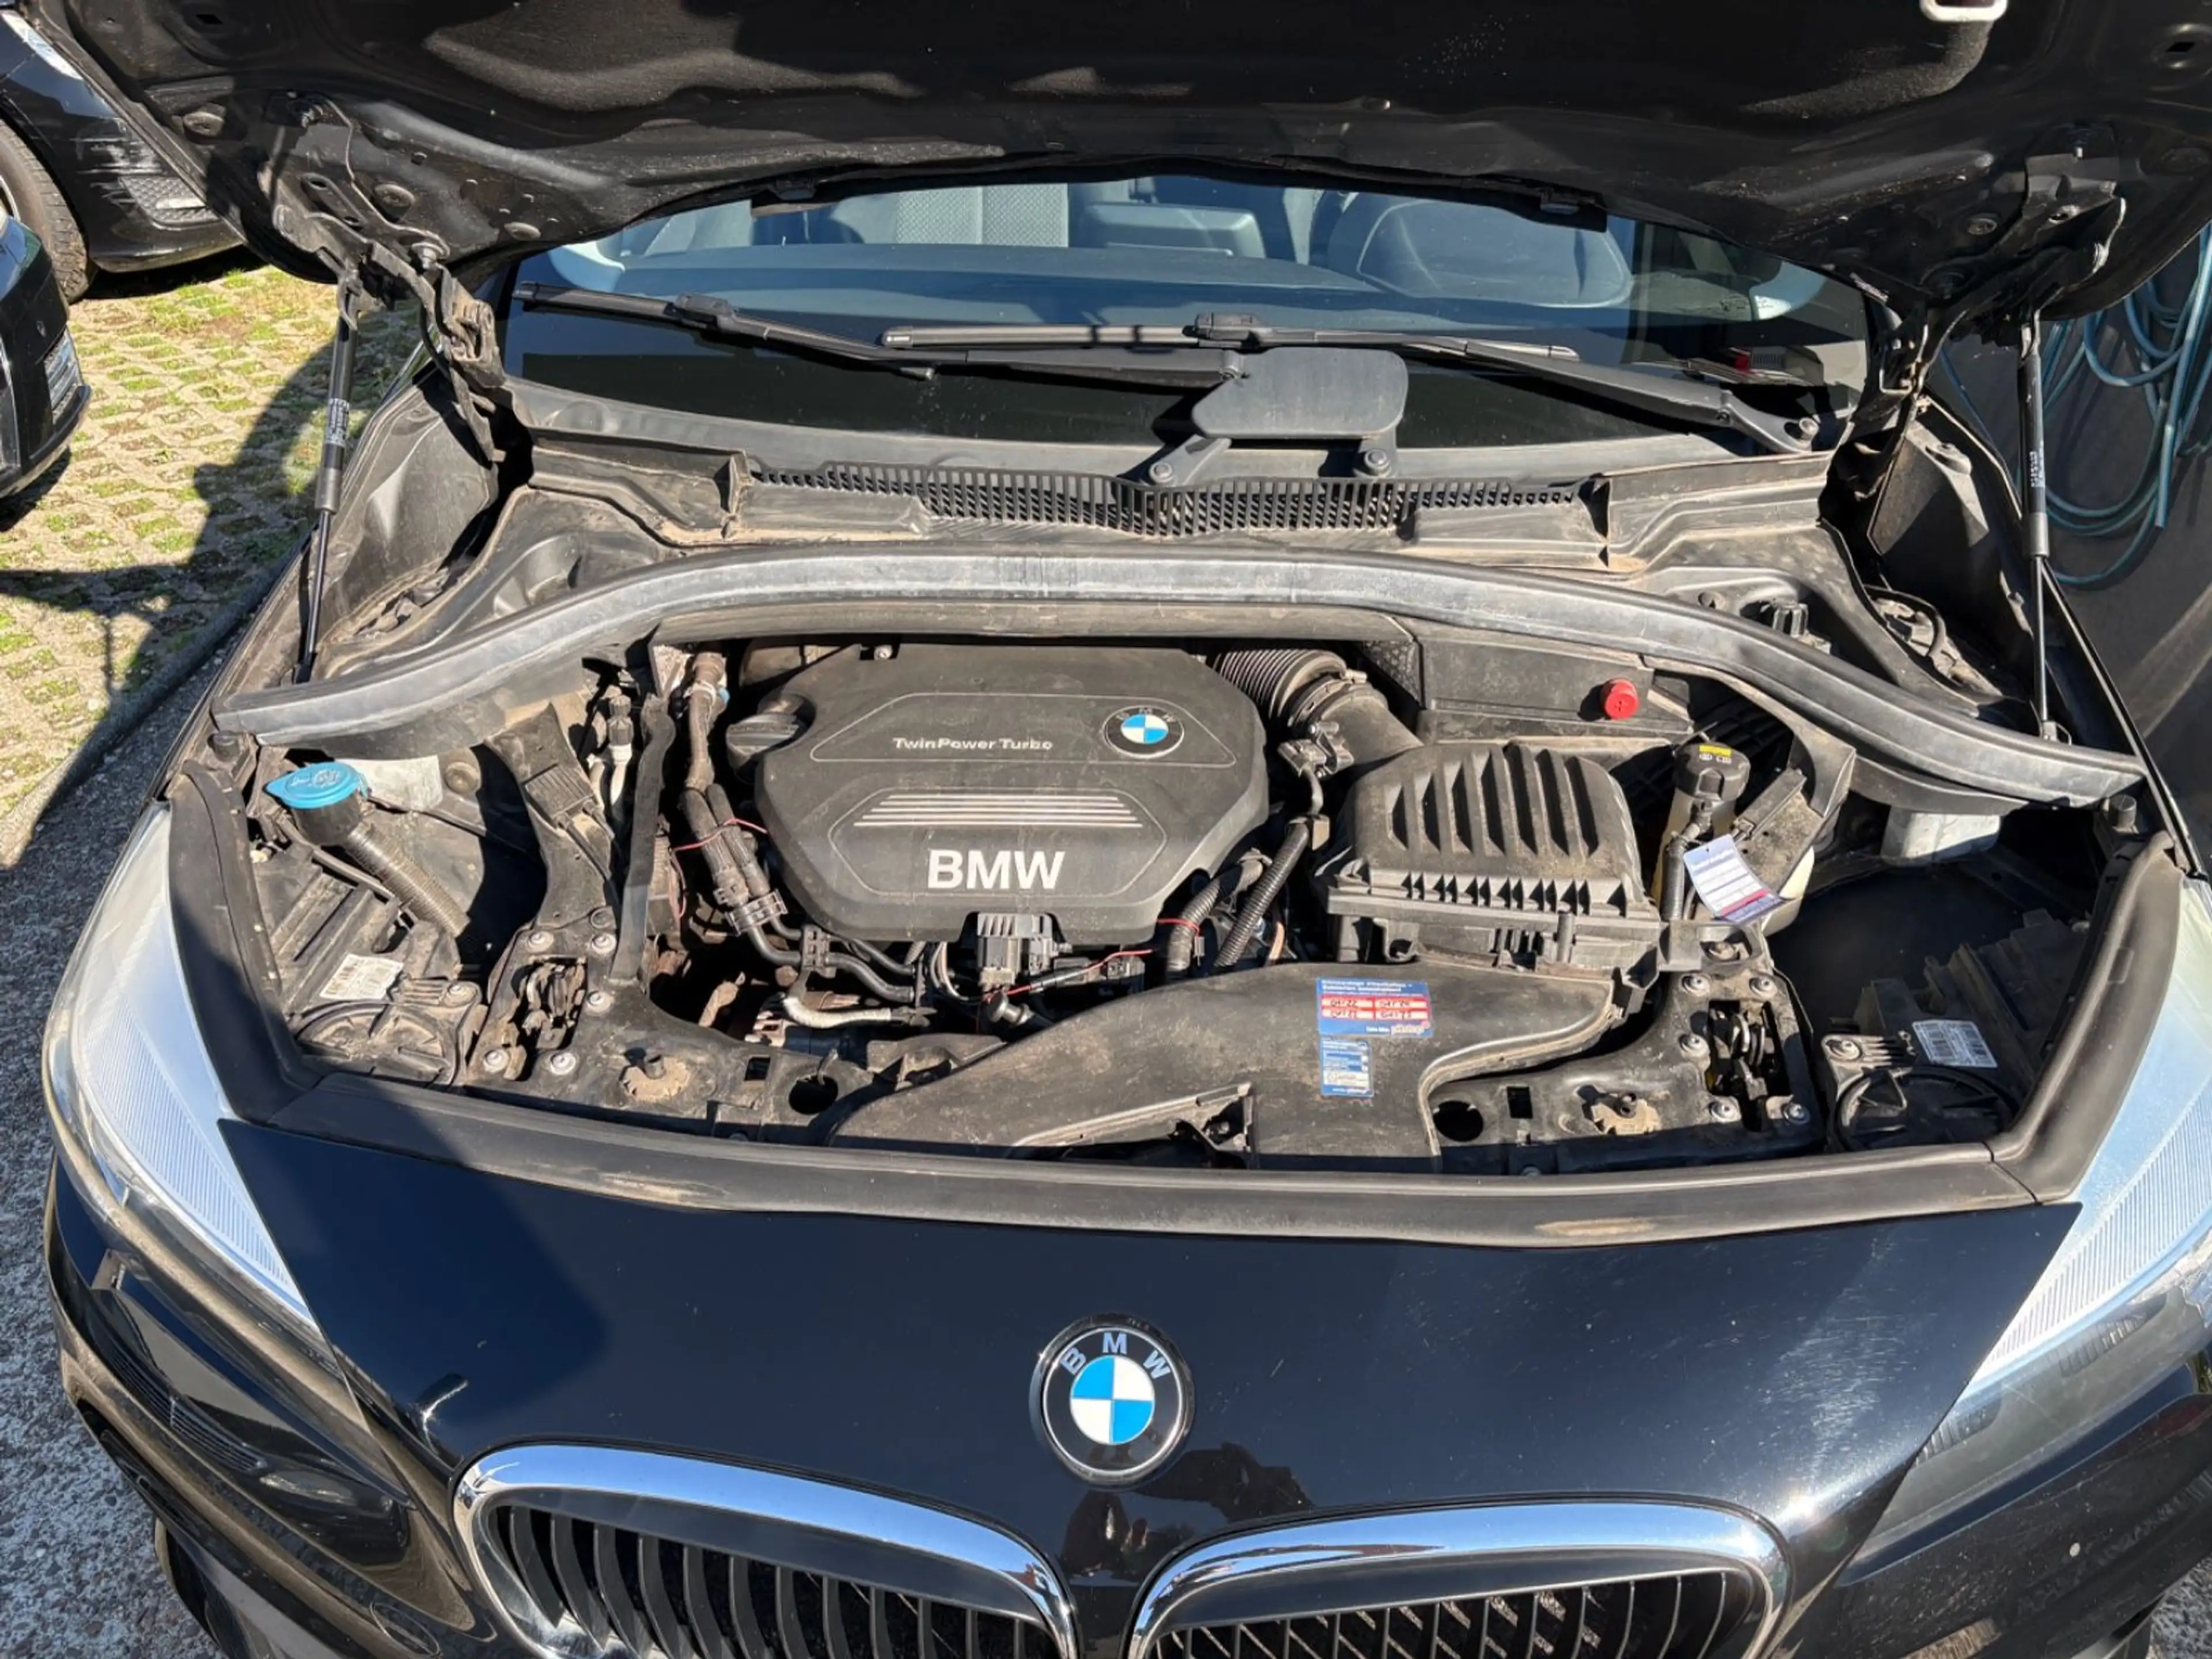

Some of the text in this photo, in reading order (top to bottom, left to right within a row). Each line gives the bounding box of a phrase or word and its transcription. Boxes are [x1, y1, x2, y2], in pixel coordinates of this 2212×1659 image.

[998, 737, 1054, 750] Turbo
[927, 850, 1066, 889] BMW
[1059, 1332, 1171, 1380] BMW
